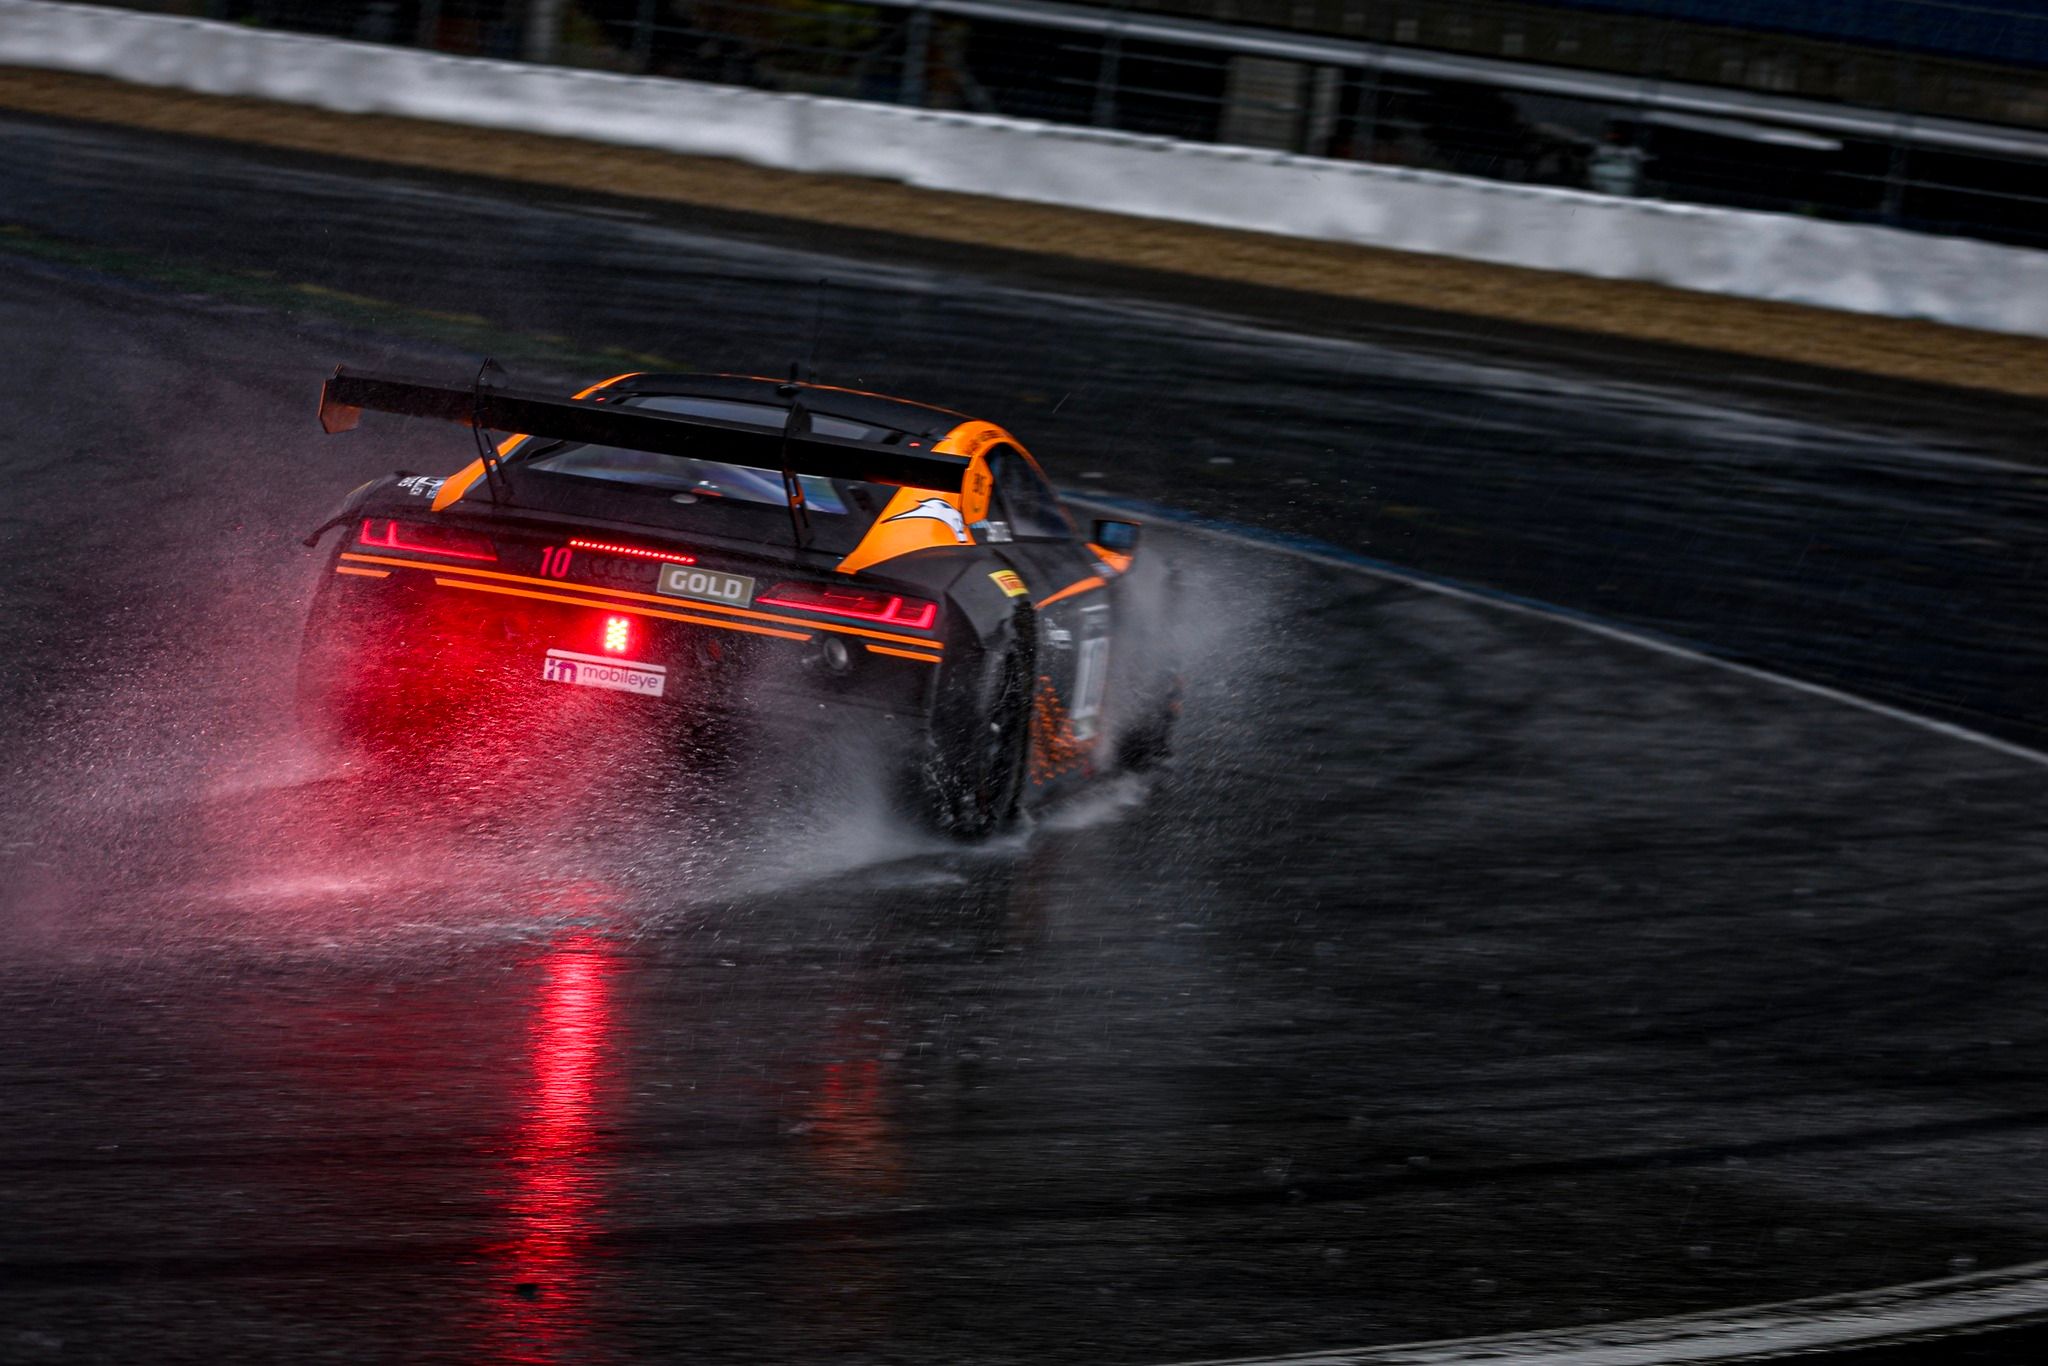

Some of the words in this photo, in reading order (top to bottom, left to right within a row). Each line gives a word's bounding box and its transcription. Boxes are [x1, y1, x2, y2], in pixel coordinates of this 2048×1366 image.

[541, 546, 572, 578] 10
[669, 570, 742, 599] GOLD
[583, 666, 658, 689] mobileye
